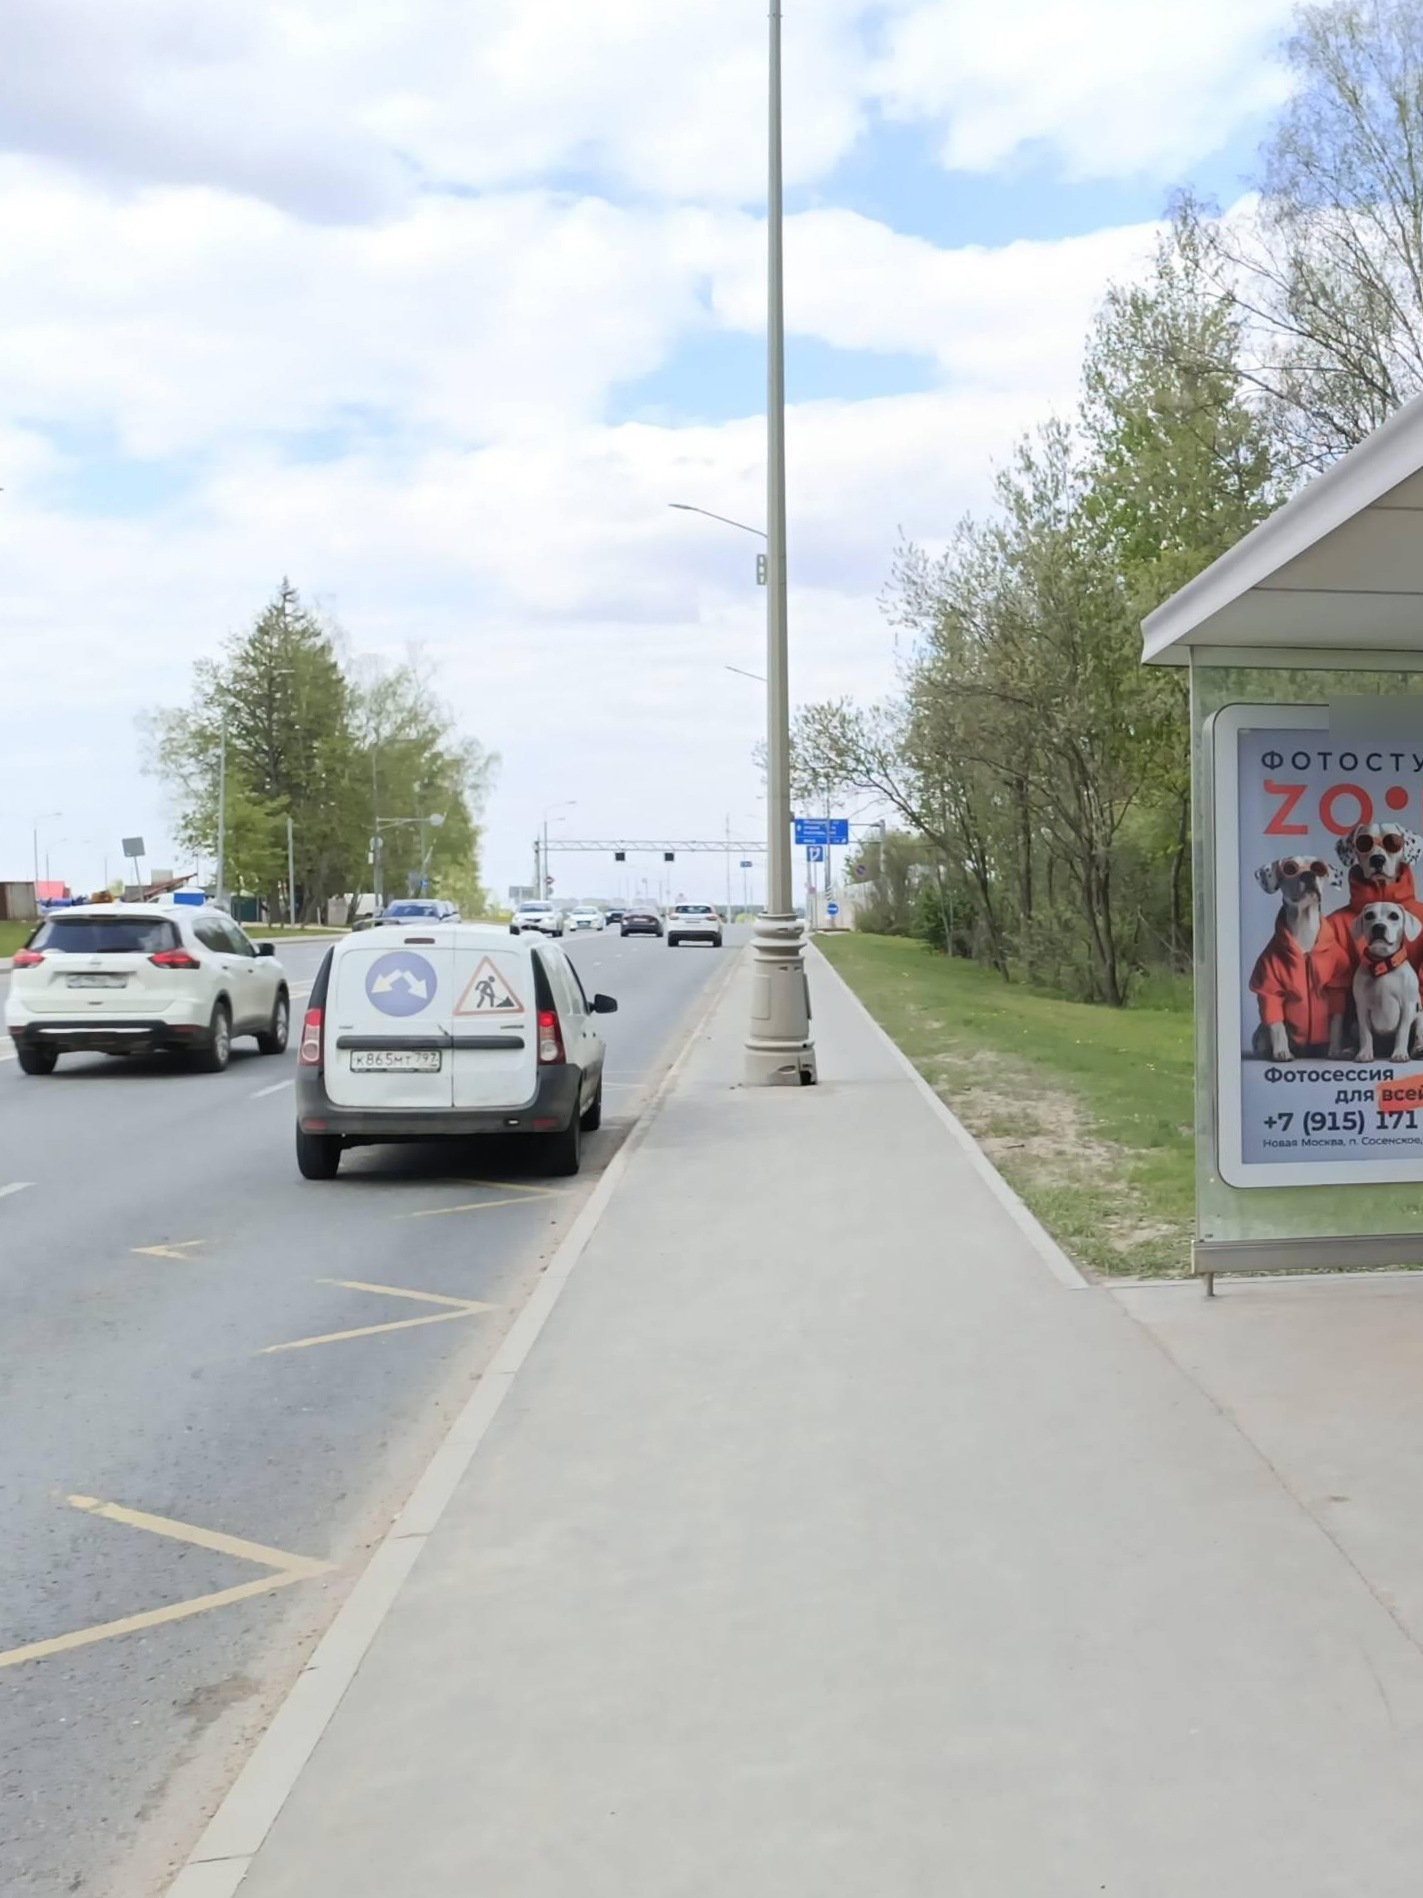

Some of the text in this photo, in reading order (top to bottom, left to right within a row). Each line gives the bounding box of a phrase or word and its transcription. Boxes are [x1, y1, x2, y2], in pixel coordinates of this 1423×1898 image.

[1264, 1067, 1394, 1083] Фотосессия
[1335, 1088, 1375, 1105] для
[1263, 1112, 1294, 1132] +7
[1302, 1110, 1366, 1136] (915)
[1376, 1110, 1418, 1130] 171
[1263, 1139, 1298, 1148] Новая
[1301, 1138, 1346, 1147] Москва,
[1361, 1136, 1423, 1146] Сосенское,
